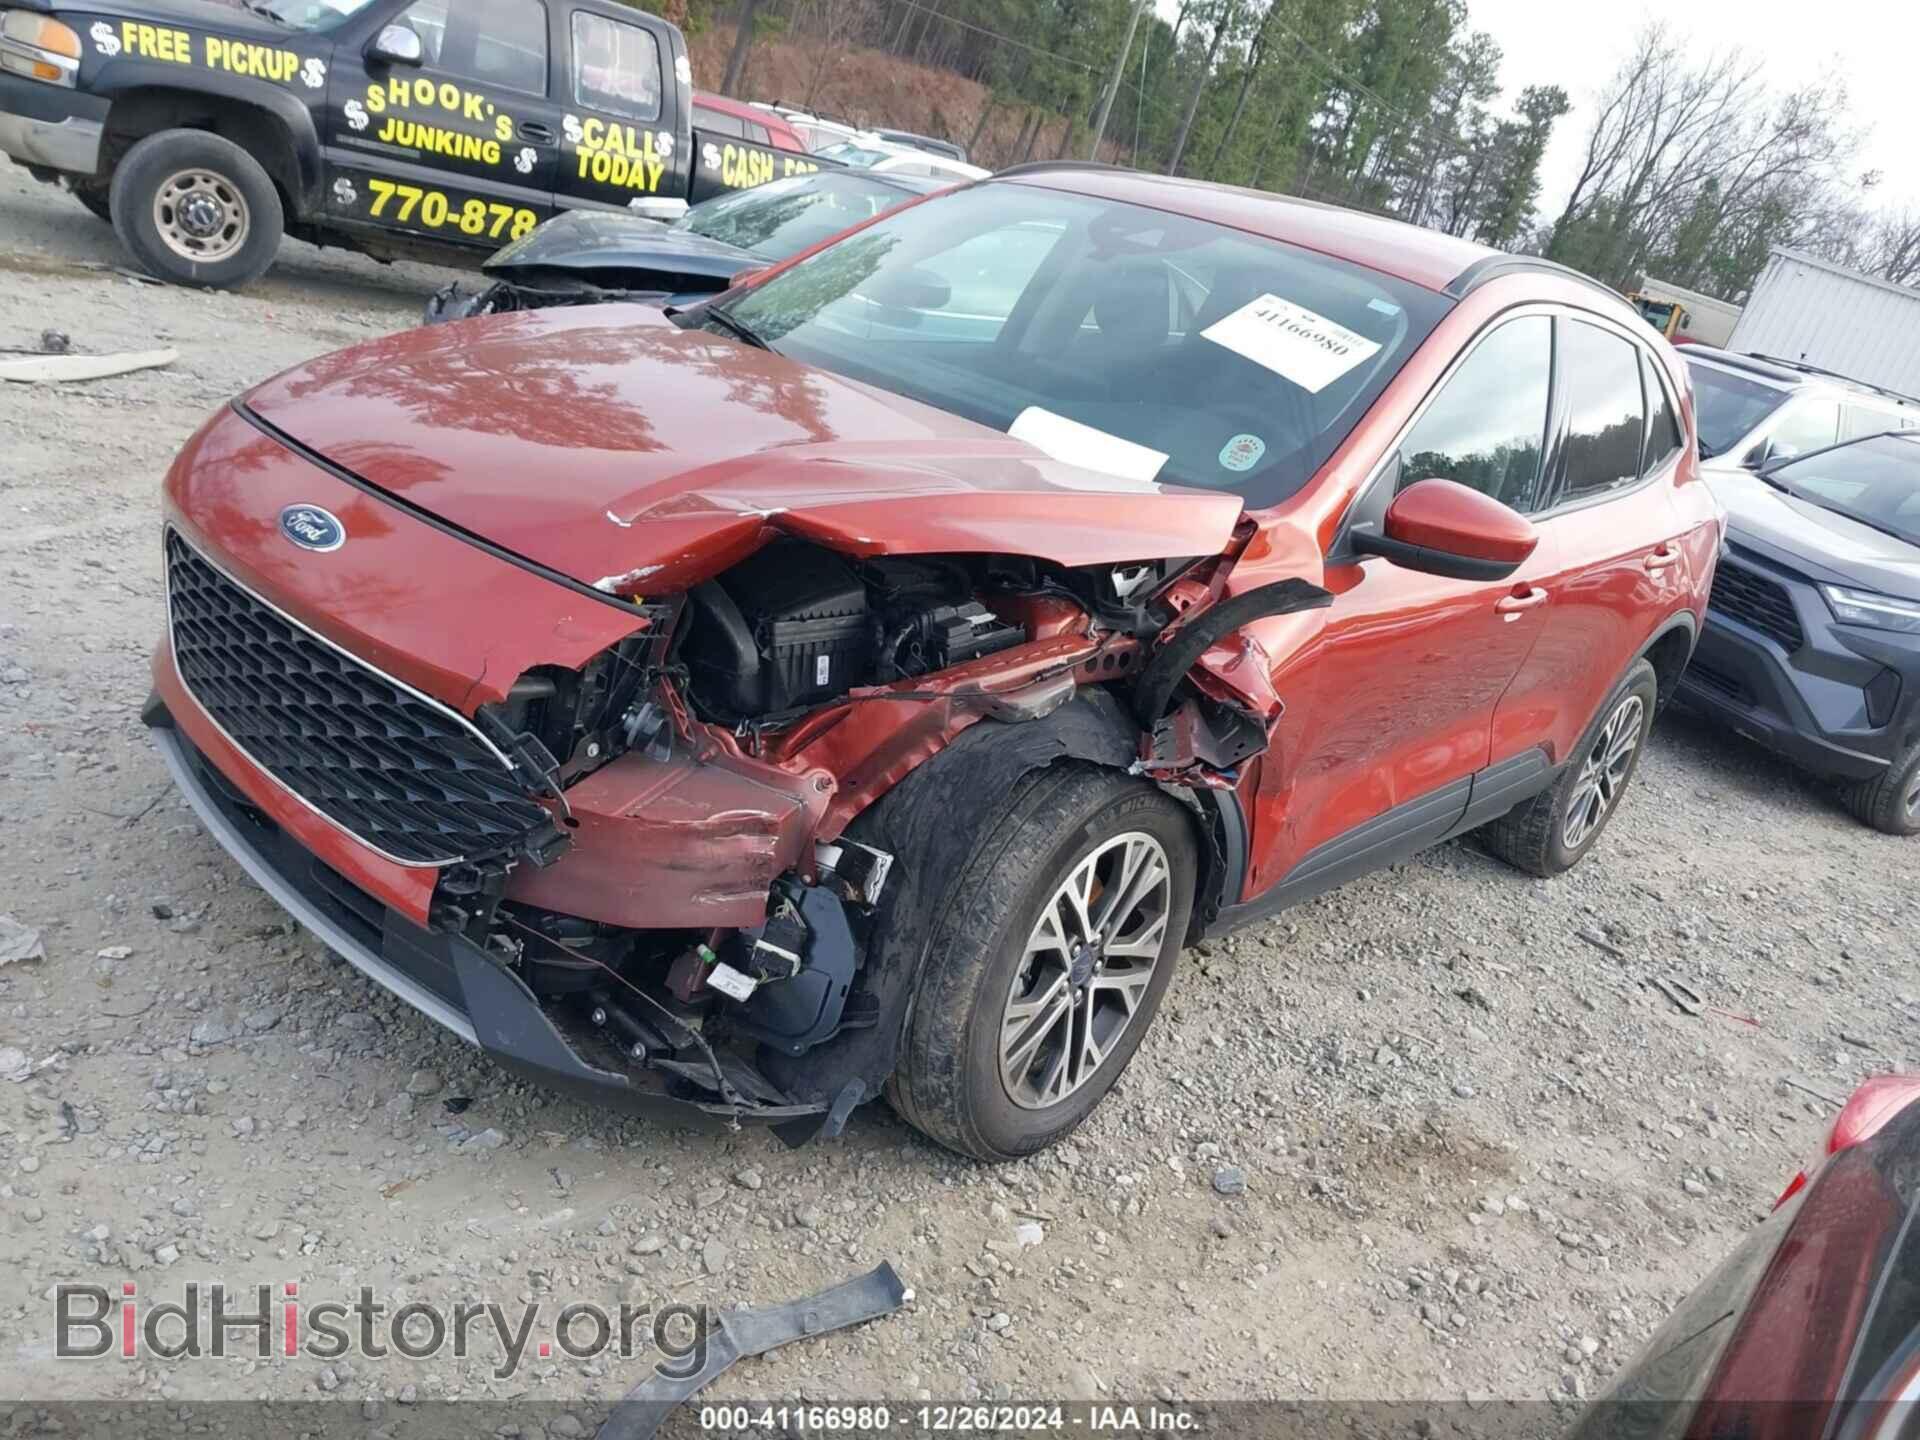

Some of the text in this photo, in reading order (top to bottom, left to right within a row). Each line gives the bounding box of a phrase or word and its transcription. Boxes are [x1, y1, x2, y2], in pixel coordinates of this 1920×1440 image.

[121, 22, 192, 64] FREE
[206, 36, 299, 82] PICKUP
[366, 78, 513, 142] SHOOK'S
[378, 118, 501, 165] JUNKING
[583, 117, 661, 163] CALL
[576, 144, 665, 192] TODAY
[722, 143, 774, 189] CASH
[368, 179, 538, 242] 770-878
[1255, 309, 1350, 356] 41166980
[286, 510, 329, 541] Ford
